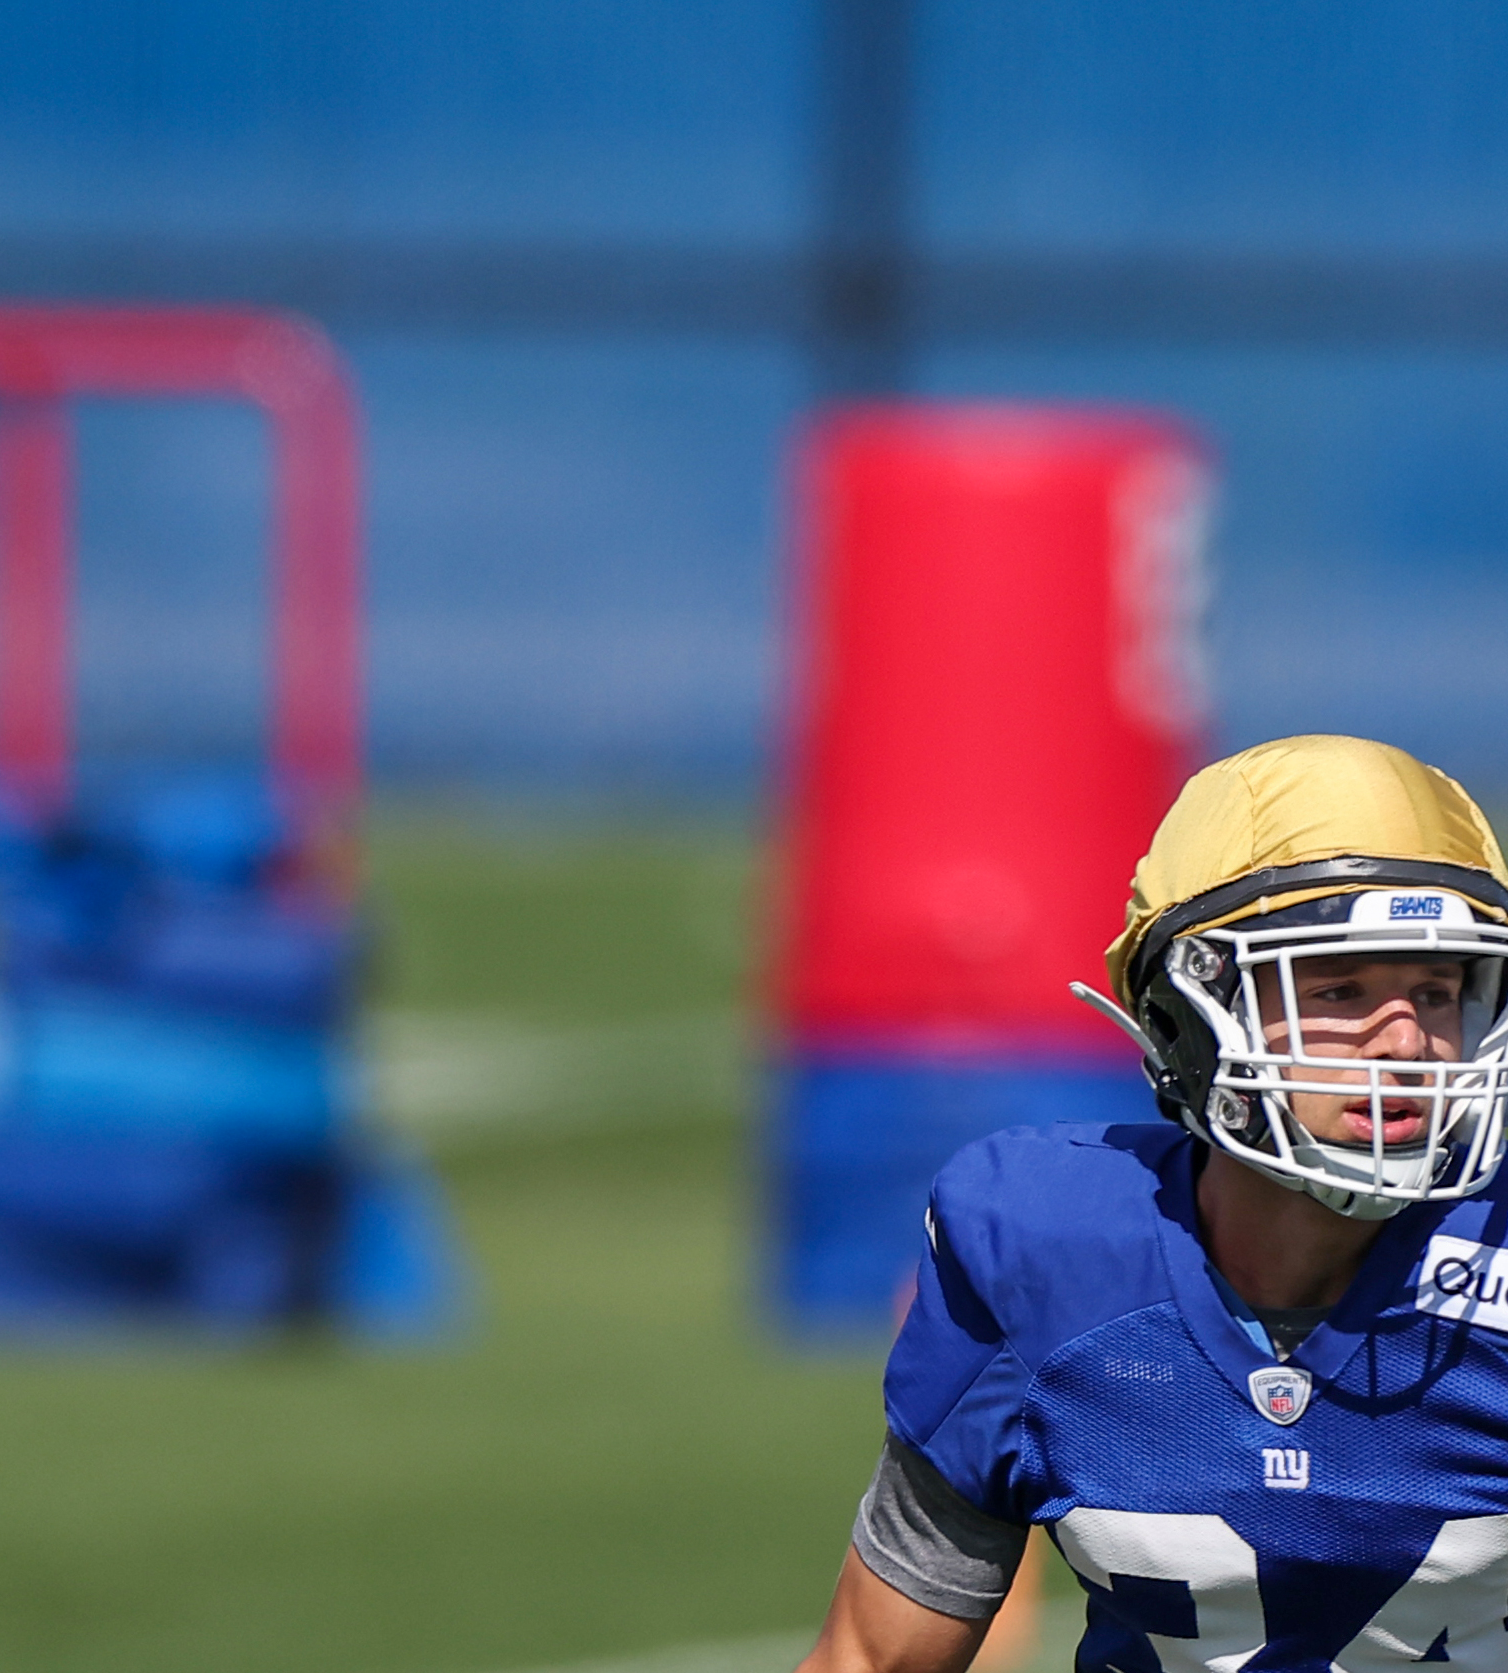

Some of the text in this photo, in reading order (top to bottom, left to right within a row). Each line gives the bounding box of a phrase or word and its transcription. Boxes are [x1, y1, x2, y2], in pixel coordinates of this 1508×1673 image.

[1390, 896, 1443, 916] GIANTS
[1257, 1375, 1306, 1387] EQUIPMENT
[1271, 1398, 1294, 1412] NFL
